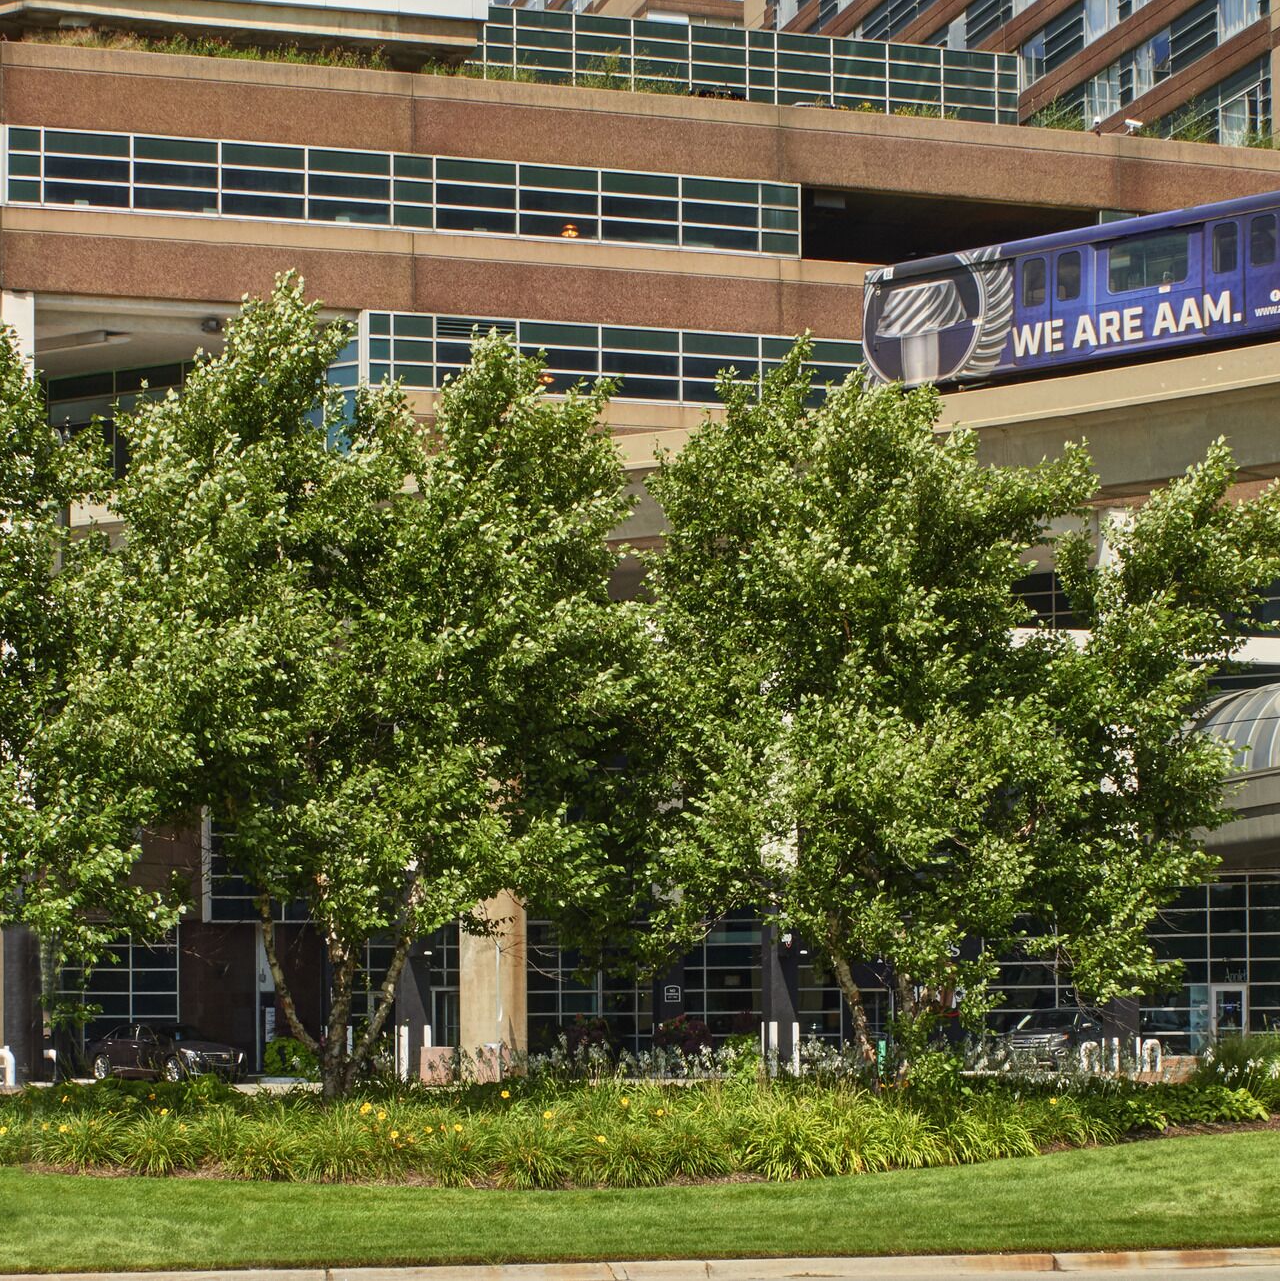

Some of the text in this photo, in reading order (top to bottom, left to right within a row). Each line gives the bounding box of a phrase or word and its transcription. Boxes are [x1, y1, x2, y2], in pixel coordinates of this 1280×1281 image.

[1013, 290, 1242, 357] WE ARE AAM.
